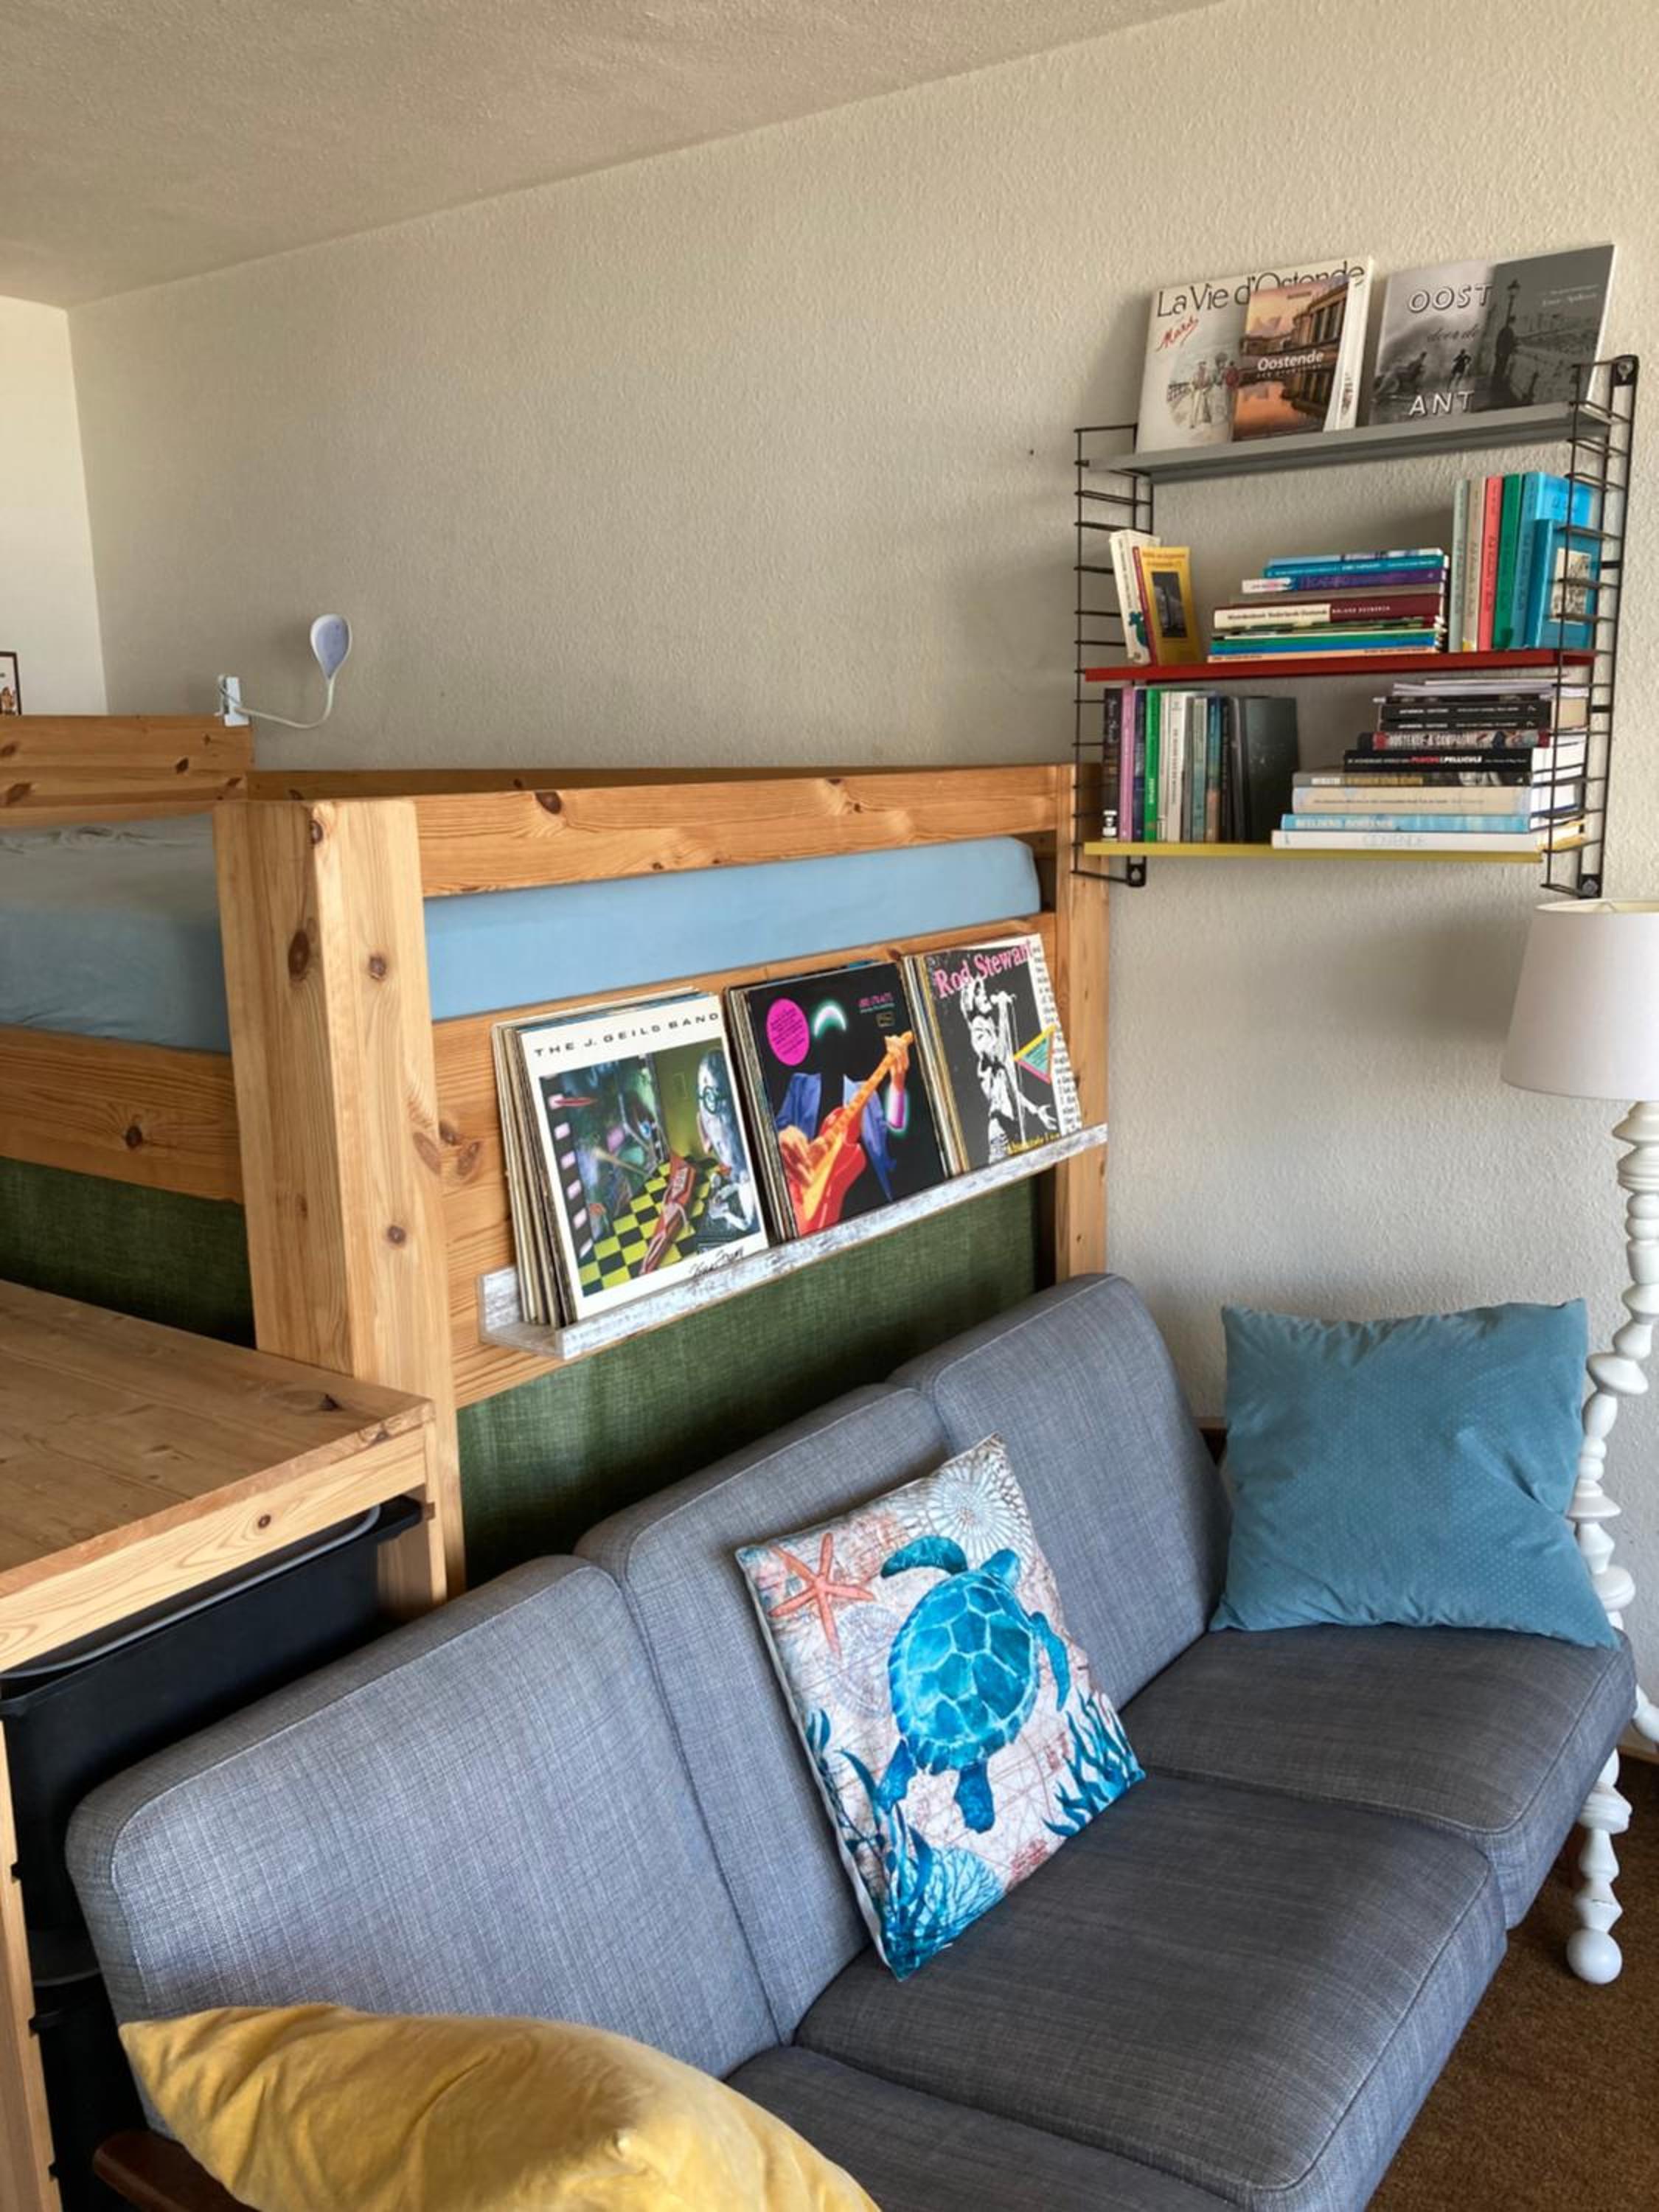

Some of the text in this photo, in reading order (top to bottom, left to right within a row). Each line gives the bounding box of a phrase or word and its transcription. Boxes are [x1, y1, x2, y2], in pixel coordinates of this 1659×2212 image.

[1157, 291, 1186, 317] La
[1190, 283, 1228, 310] Vie
[1256, 349, 1324, 371] Oostende
[933, 939, 1032, 999] Rod Stewart
[534, 1043, 574, 1057] THE
[584, 1038, 597, 1048] J.
[668, 1012, 719, 1029] BAND
